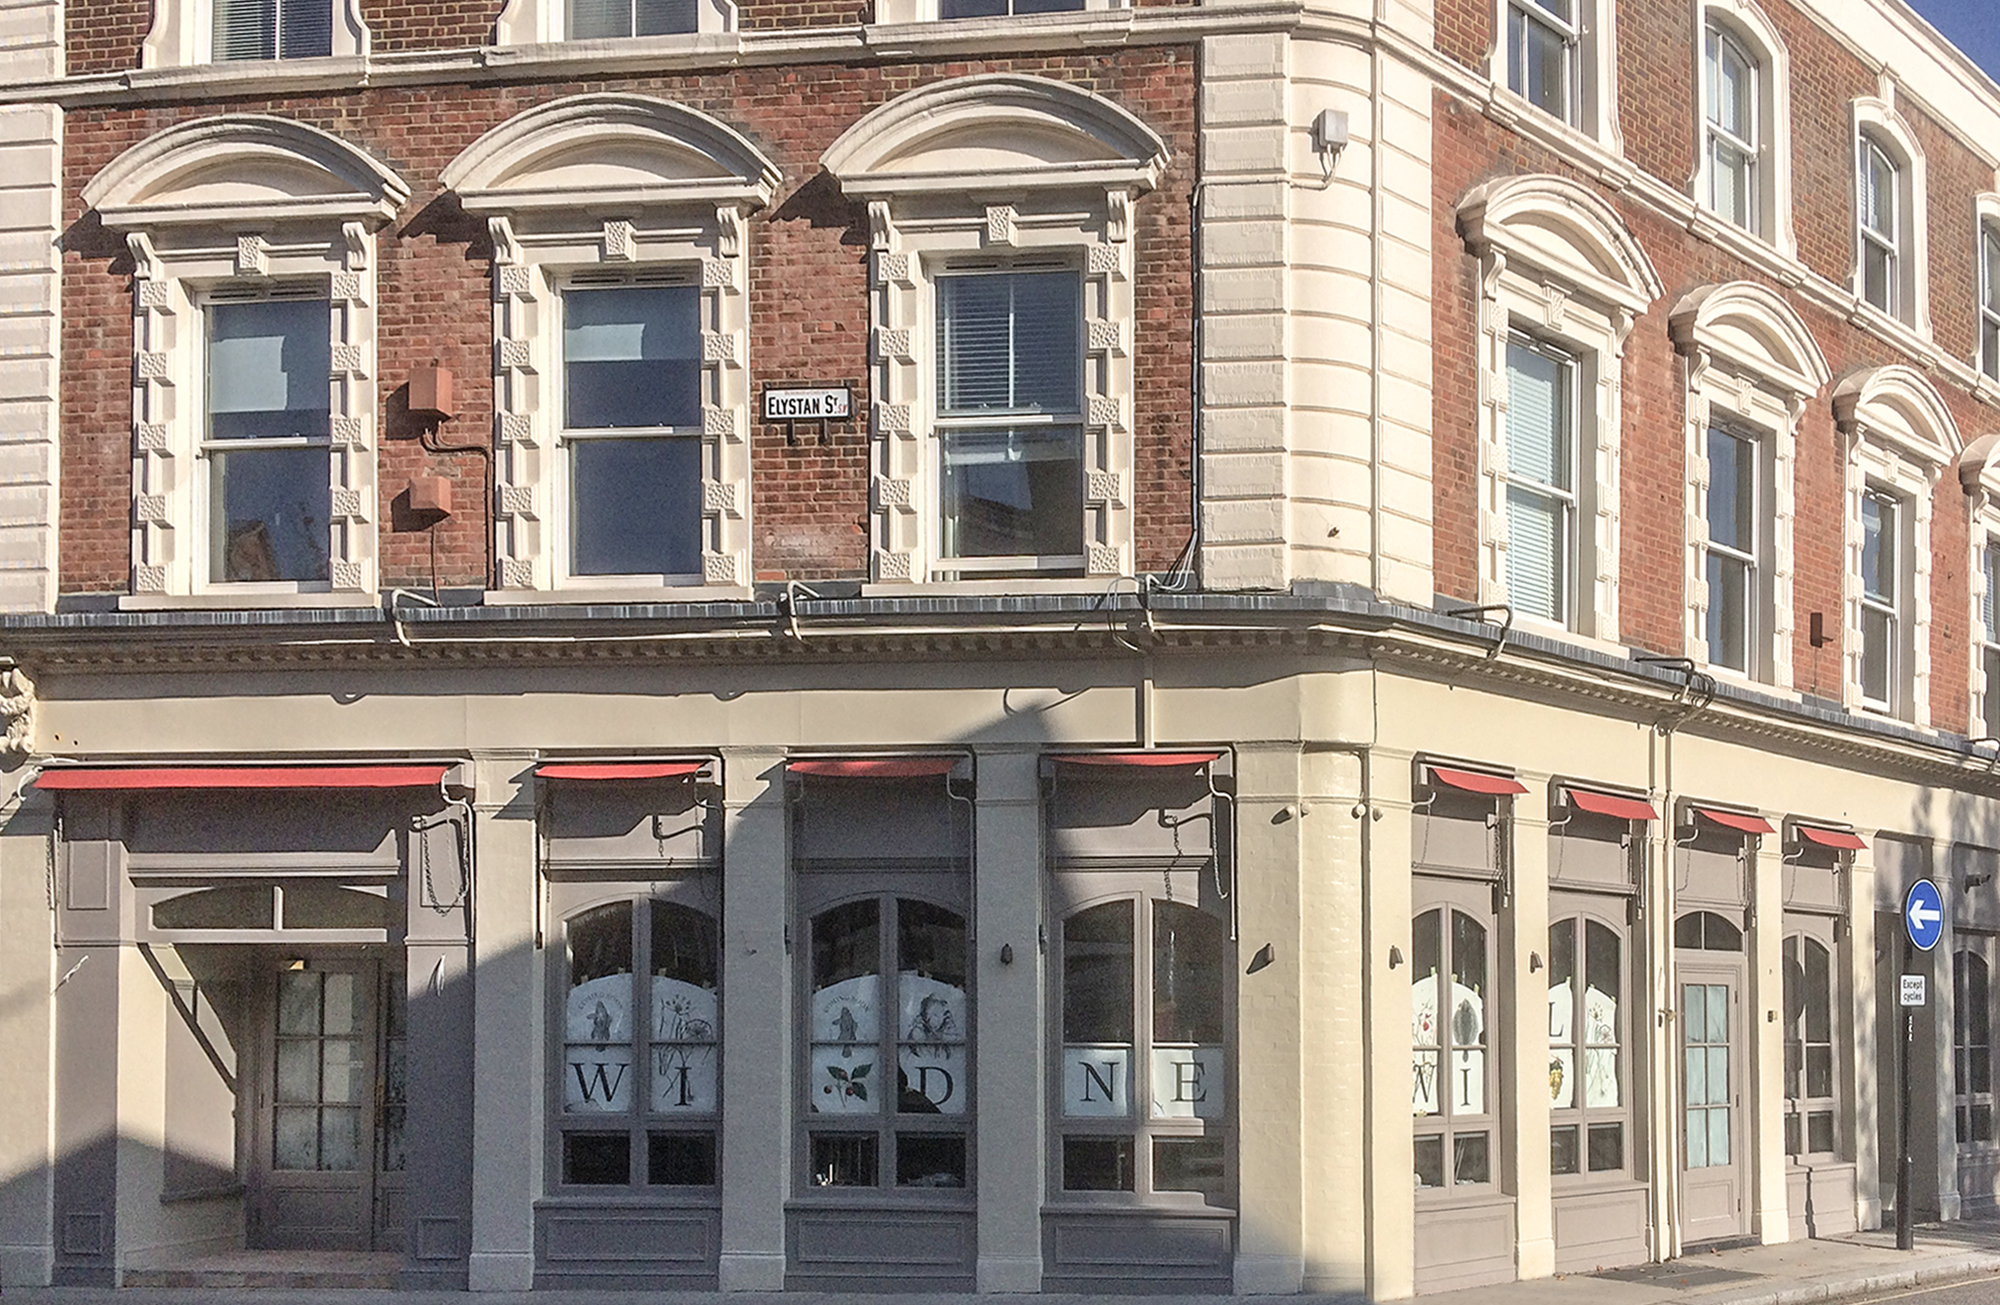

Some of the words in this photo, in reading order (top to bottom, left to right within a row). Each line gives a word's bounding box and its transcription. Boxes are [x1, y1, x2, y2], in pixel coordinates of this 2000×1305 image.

[768, 397, 820, 415] ELYSTAN
[1903, 979, 1923, 990] Except
[1903, 991, 1922, 1002] cycles
